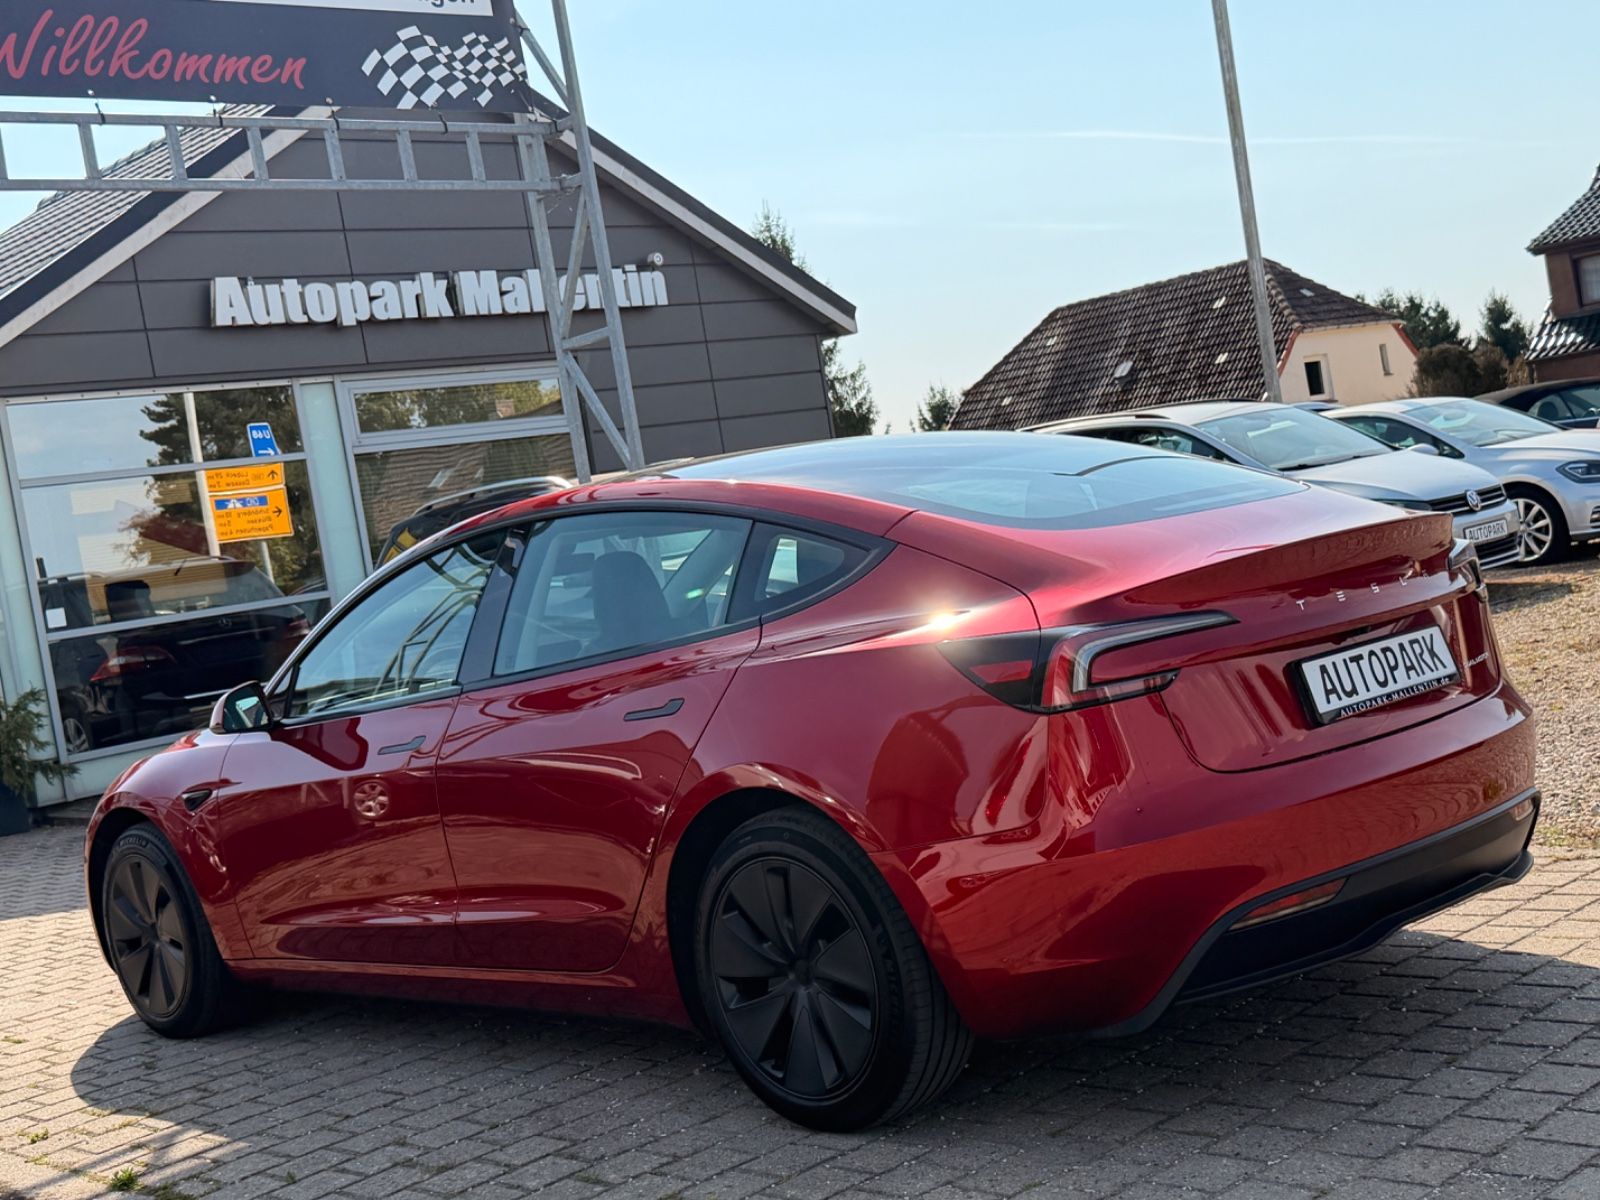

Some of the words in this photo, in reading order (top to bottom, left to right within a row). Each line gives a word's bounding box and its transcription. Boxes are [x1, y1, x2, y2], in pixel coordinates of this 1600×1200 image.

[0, 9, 307, 90] Willkommen
[211, 271, 455, 328] Autopark
[456, 263, 669, 317] Malentin
[1468, 521, 1505, 540] AUTOPARK
[1319, 633, 1447, 705] AUTOPARK
